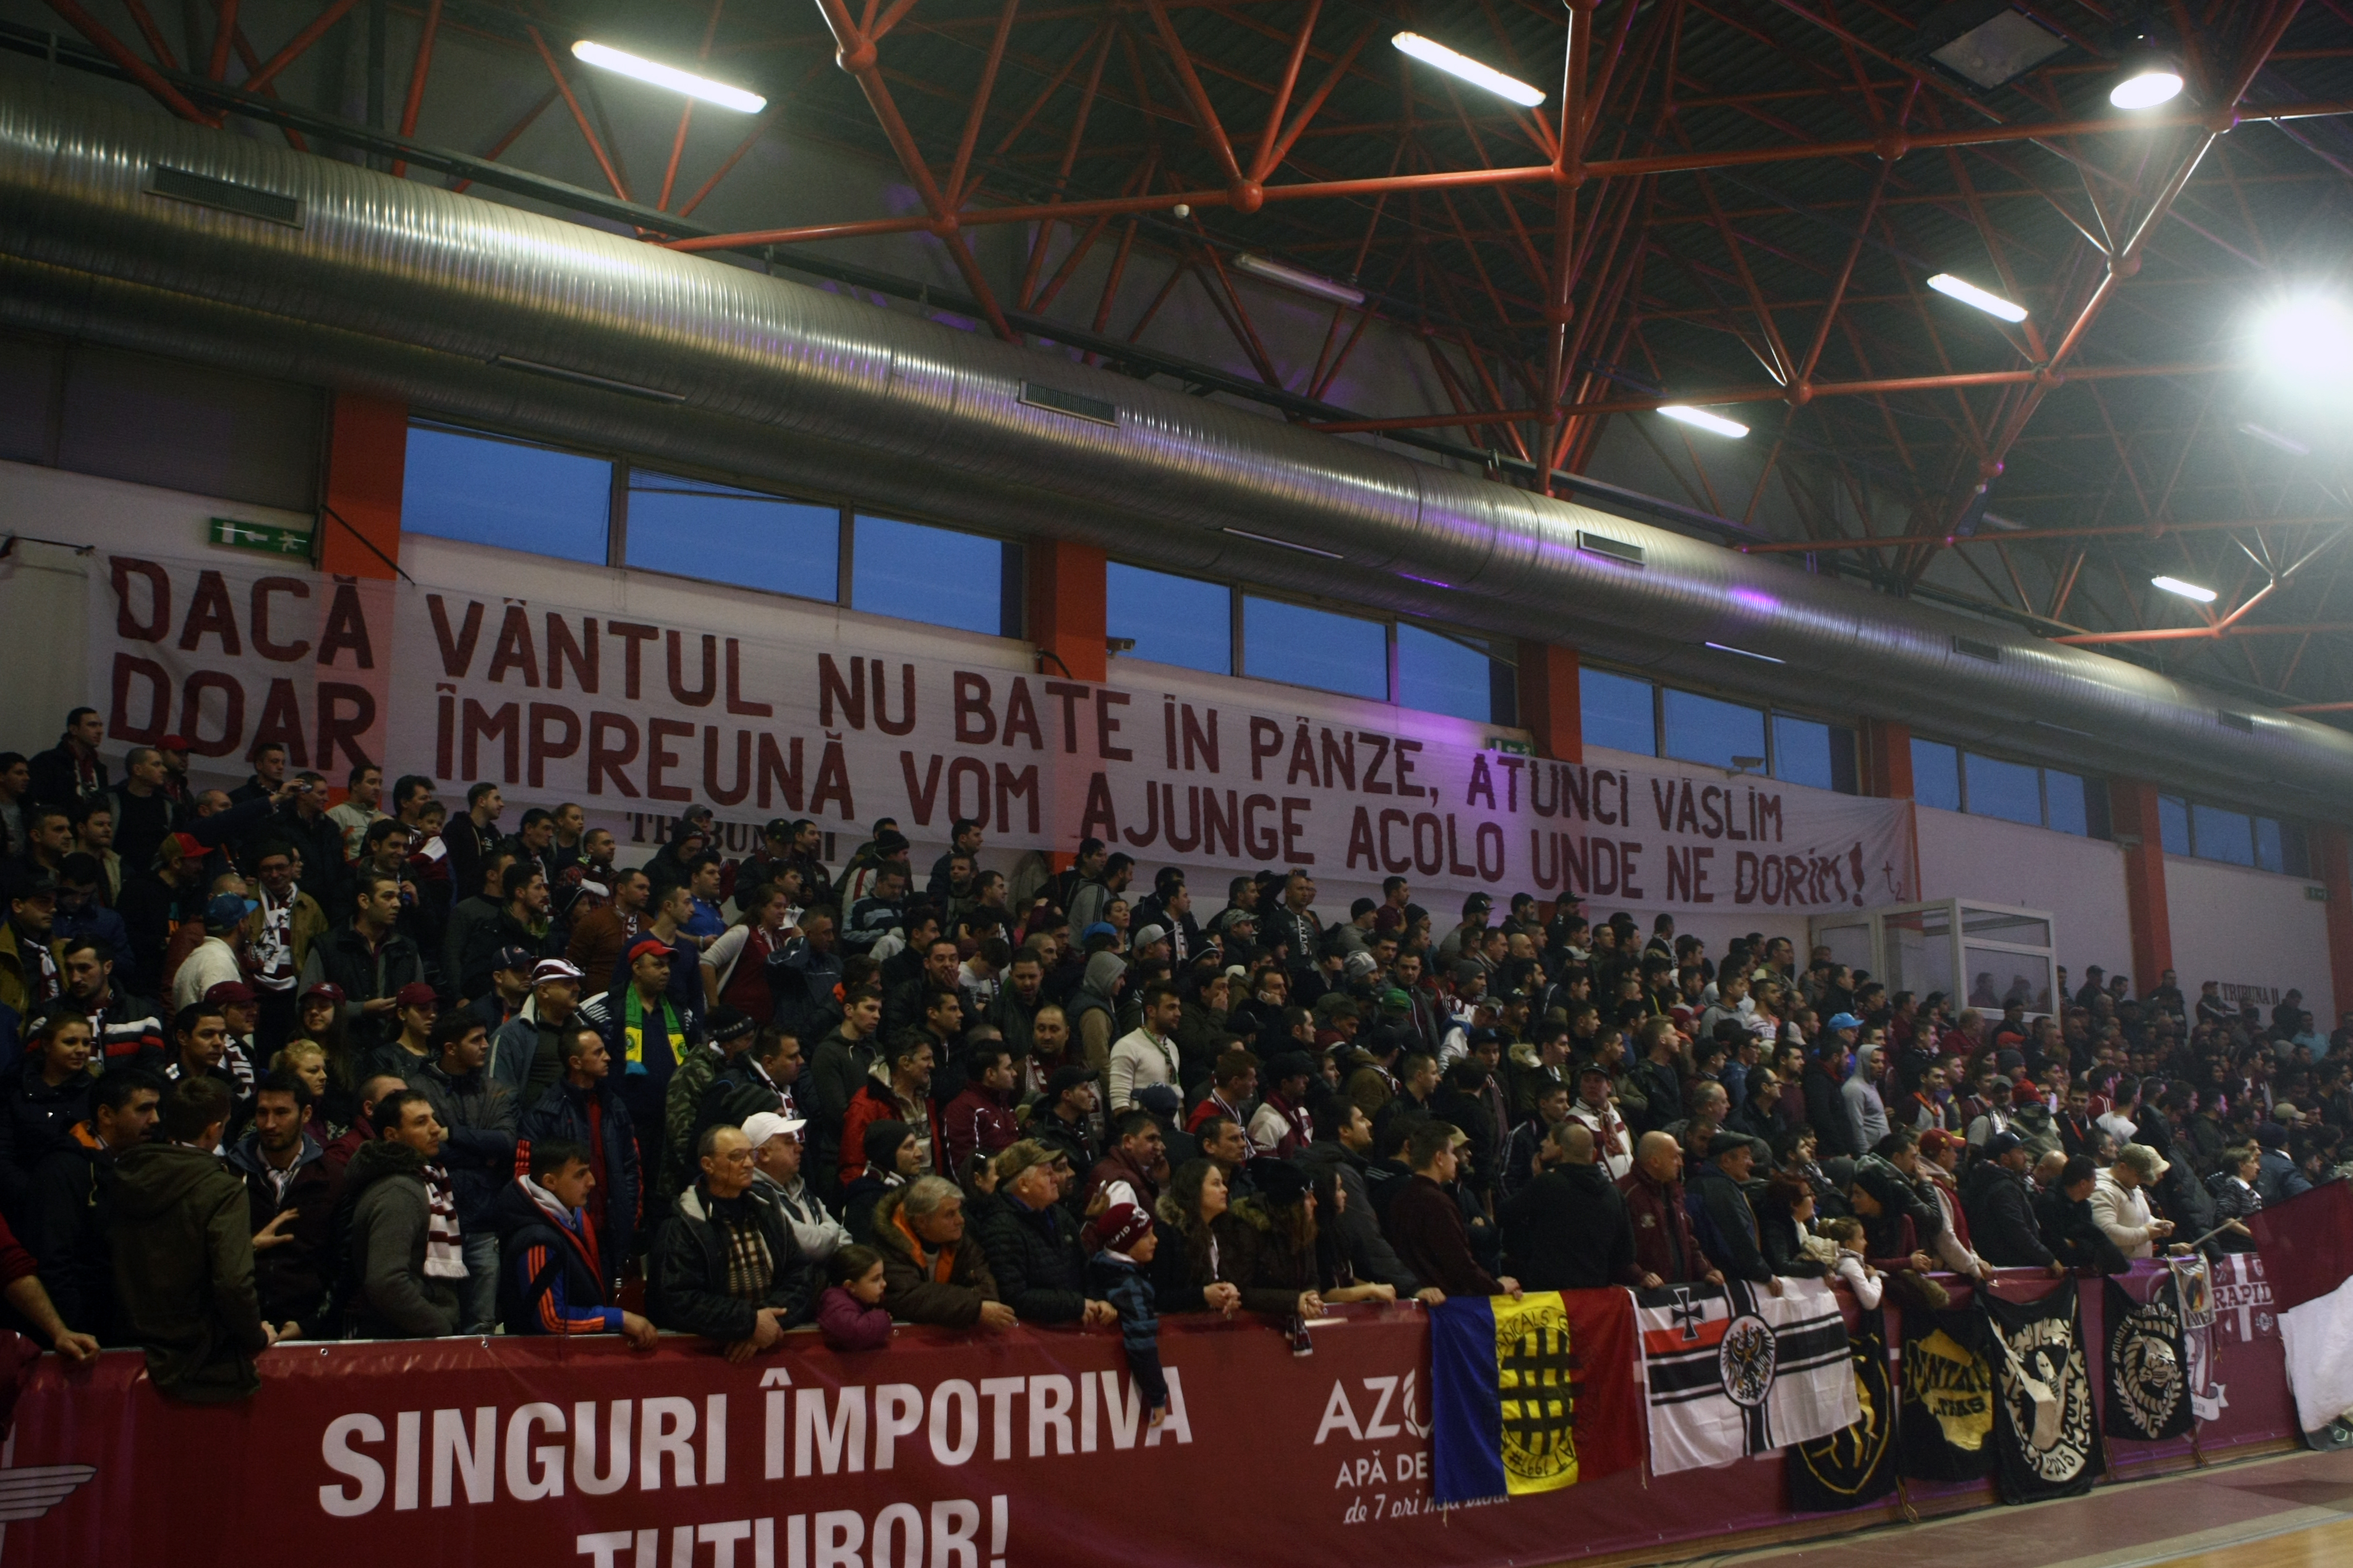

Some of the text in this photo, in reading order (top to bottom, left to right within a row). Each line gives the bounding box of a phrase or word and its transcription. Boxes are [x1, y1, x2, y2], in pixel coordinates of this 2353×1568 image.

[109, 555, 374, 669] DACĂ
[426, 593, 772, 717] VÂNTUL
[819, 653, 916, 735] NU
[954, 671, 1132, 761] BATE
[1164, 693, 1219, 773] ÎN
[1250, 716, 1438, 807] PÂNZE,
[108, 652, 376, 771] DOAR
[436, 682, 854, 820] ÎMPREUNĂ
[900, 750, 1040, 833] VOM
[1080, 773, 1314, 865] AJUNGE
[1346, 806, 1504, 883] ACOLO
[1531, 829, 1643, 899] UNDE
[1667, 845, 1714, 903] NE
[2213, 1283, 2273, 1310] RAPID
[319, 1367, 1193, 1517] SINGURI ÎMPOTRIVA
[1334, 1449, 1428, 1490] APĂ DE
[1343, 1496, 1368, 1524] de
[1374, 1493, 1386, 1520] 7
[1390, 1488, 1420, 1518] ori
